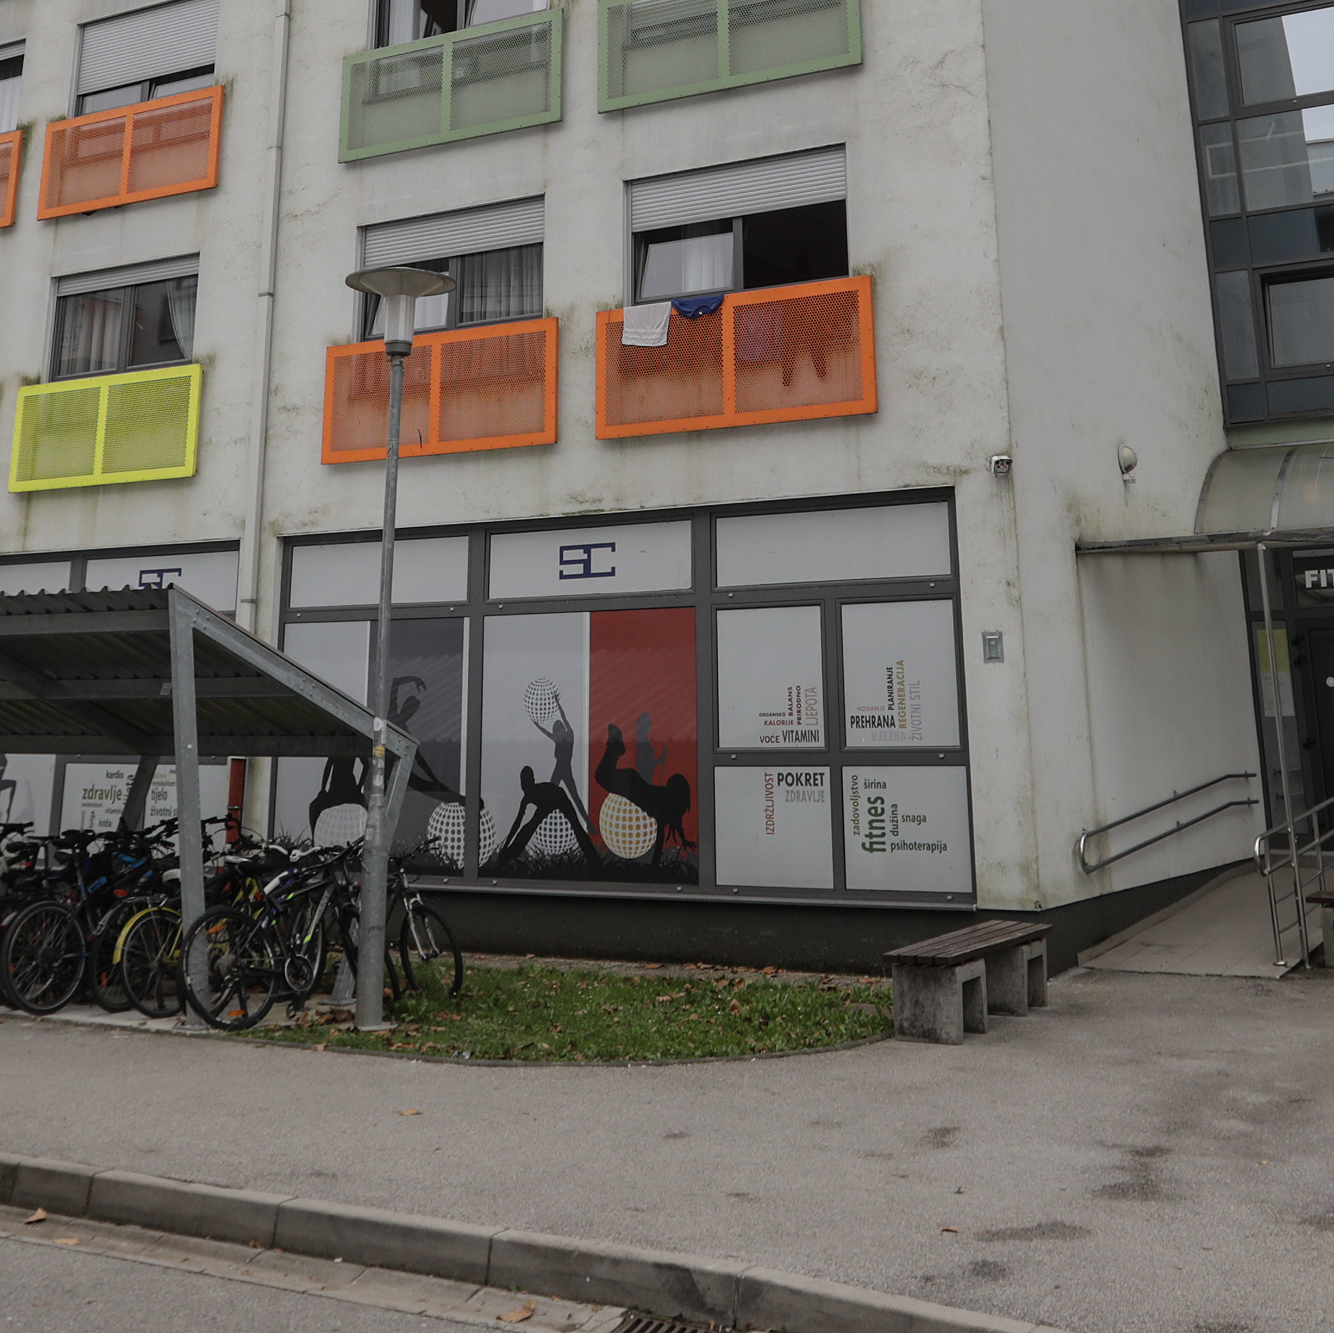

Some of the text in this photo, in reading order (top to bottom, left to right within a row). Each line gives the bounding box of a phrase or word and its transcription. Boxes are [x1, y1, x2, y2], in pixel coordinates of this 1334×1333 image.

[886, 666, 895, 711] PLANIRANJE
[896, 659, 907, 729] REGENERACIJA
[909, 680, 921, 701] STIL
[850, 715, 896, 729] PREHRANA
[782, 729, 819, 743] VITAMINI
[777, 772, 825, 787] POKRET
[864, 779, 887, 789] širina
[82, 784, 122, 805] zdravlje
[785, 790, 825, 803] ZDRAVLJE
[850, 775, 861, 836] zadovoljstvo
[861, 796, 886, 853] fitnes
[889, 804, 899, 836] dužina
[901, 814, 927, 826] snaga
[890, 840, 947, 854] psihoterapija
